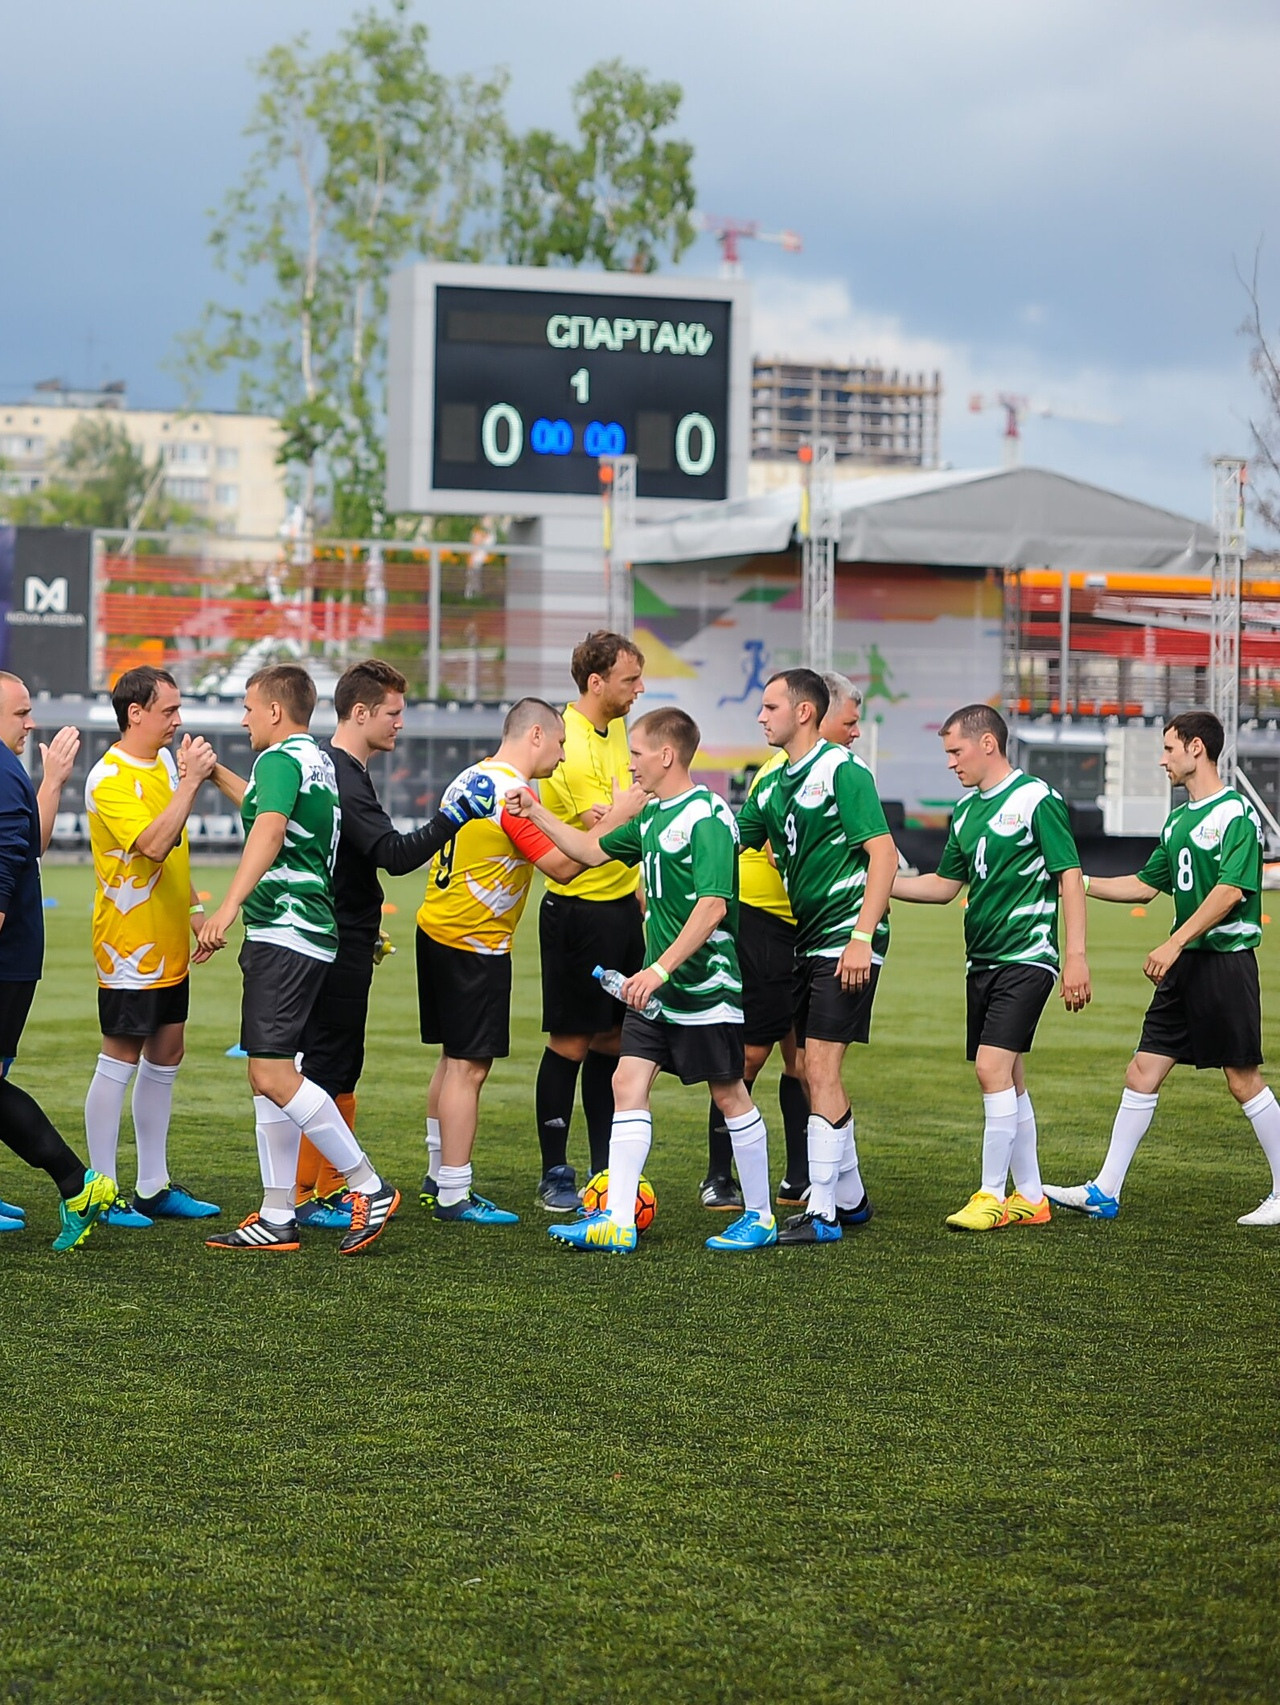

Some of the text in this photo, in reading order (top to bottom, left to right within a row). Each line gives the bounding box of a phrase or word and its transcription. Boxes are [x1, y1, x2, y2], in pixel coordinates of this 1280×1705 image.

[570, 367, 590, 403] 1
[482, 402, 523, 467] 0
[675, 412, 716, 476] 0
[784, 812, 798, 857] 9
[435, 837, 456, 890] 9
[644, 851, 662, 899] 11
[974, 836, 988, 880] 4
[1177, 847, 1193, 892] 8
[585, 1221, 634, 1247] NIKE
